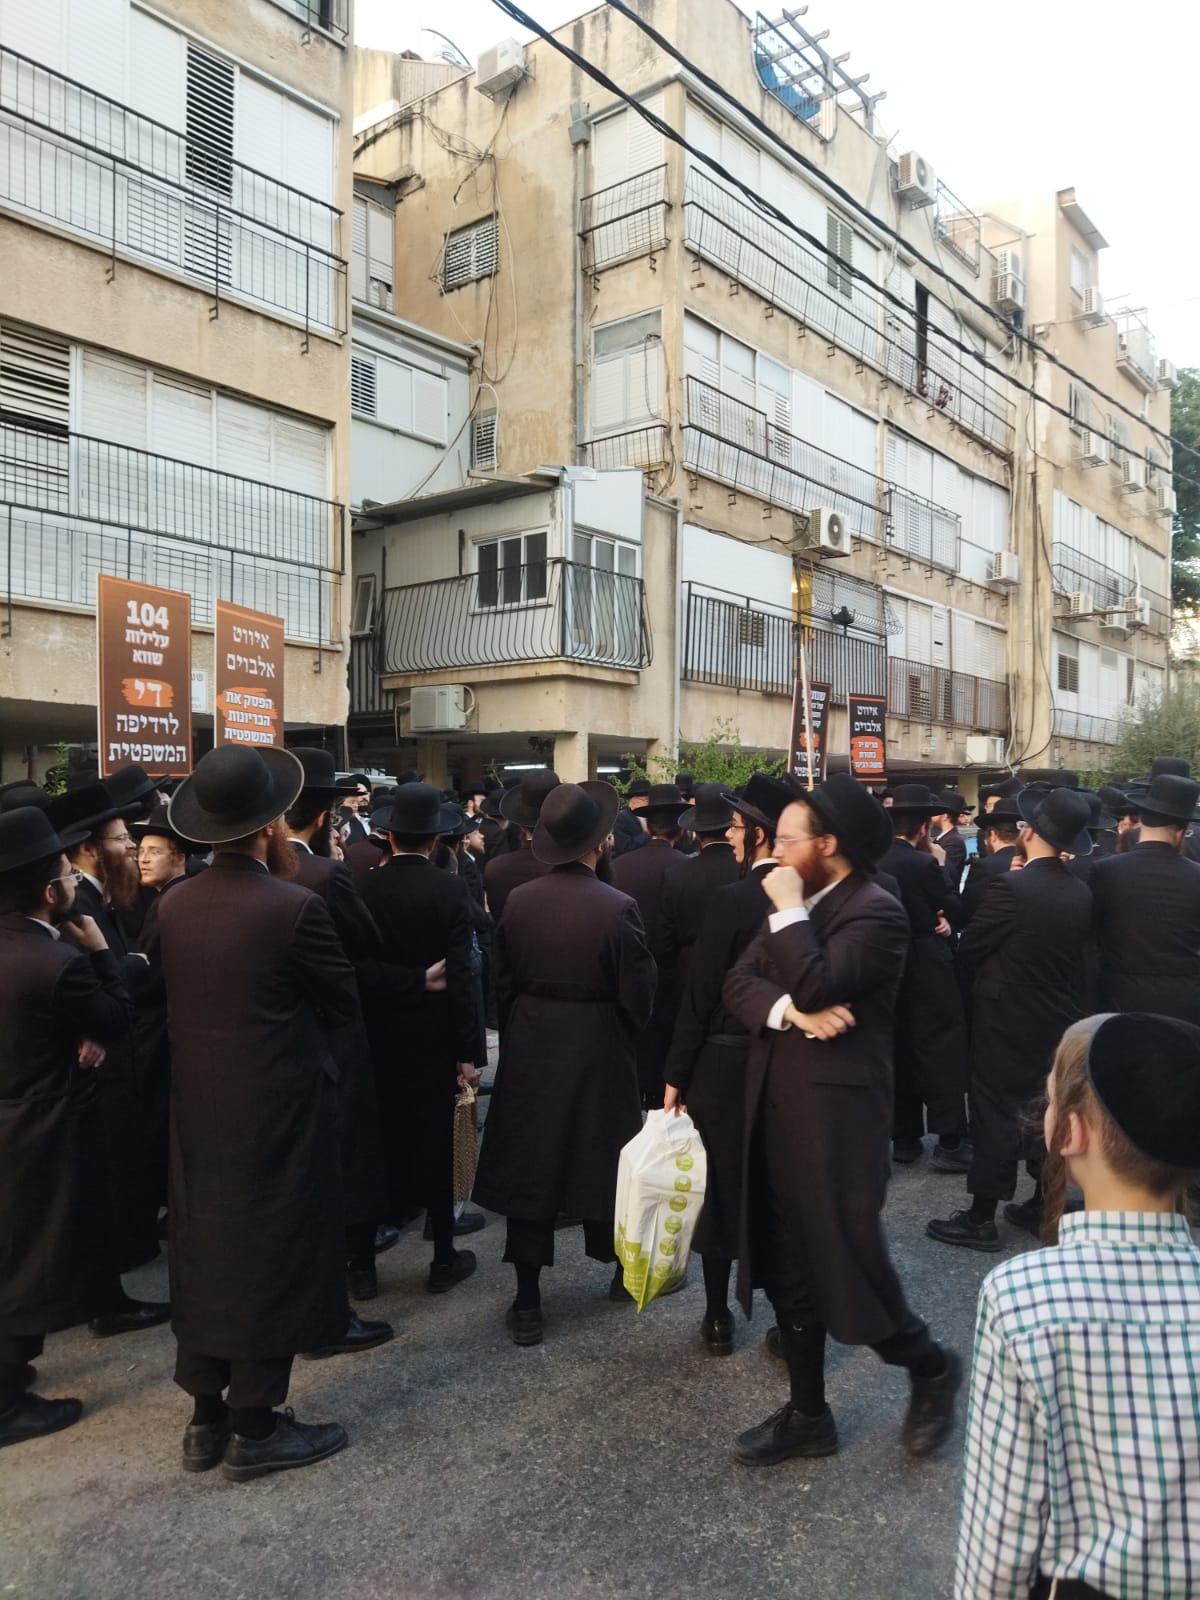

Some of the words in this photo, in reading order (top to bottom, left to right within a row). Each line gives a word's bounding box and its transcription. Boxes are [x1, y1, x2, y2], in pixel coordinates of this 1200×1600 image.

[127, 600, 169, 630] 104
[125, 629, 170, 648] עלילות
[232, 625, 270, 649] איווט
[132, 649, 164, 666] שווא
[226, 653, 275, 678] אלבוים
[134, 679, 162, 708] די
[225, 691, 242, 705] את
[243, 694, 273, 710] הפסק
[228, 710, 270, 727] הבריונות
[857, 705, 878, 716] איווט
[116, 712, 179, 736] לרדיפה
[854, 720, 882, 732] אלבוים
[224, 727, 274, 745] המשפטית
[108, 742, 187, 763] המשפטית
